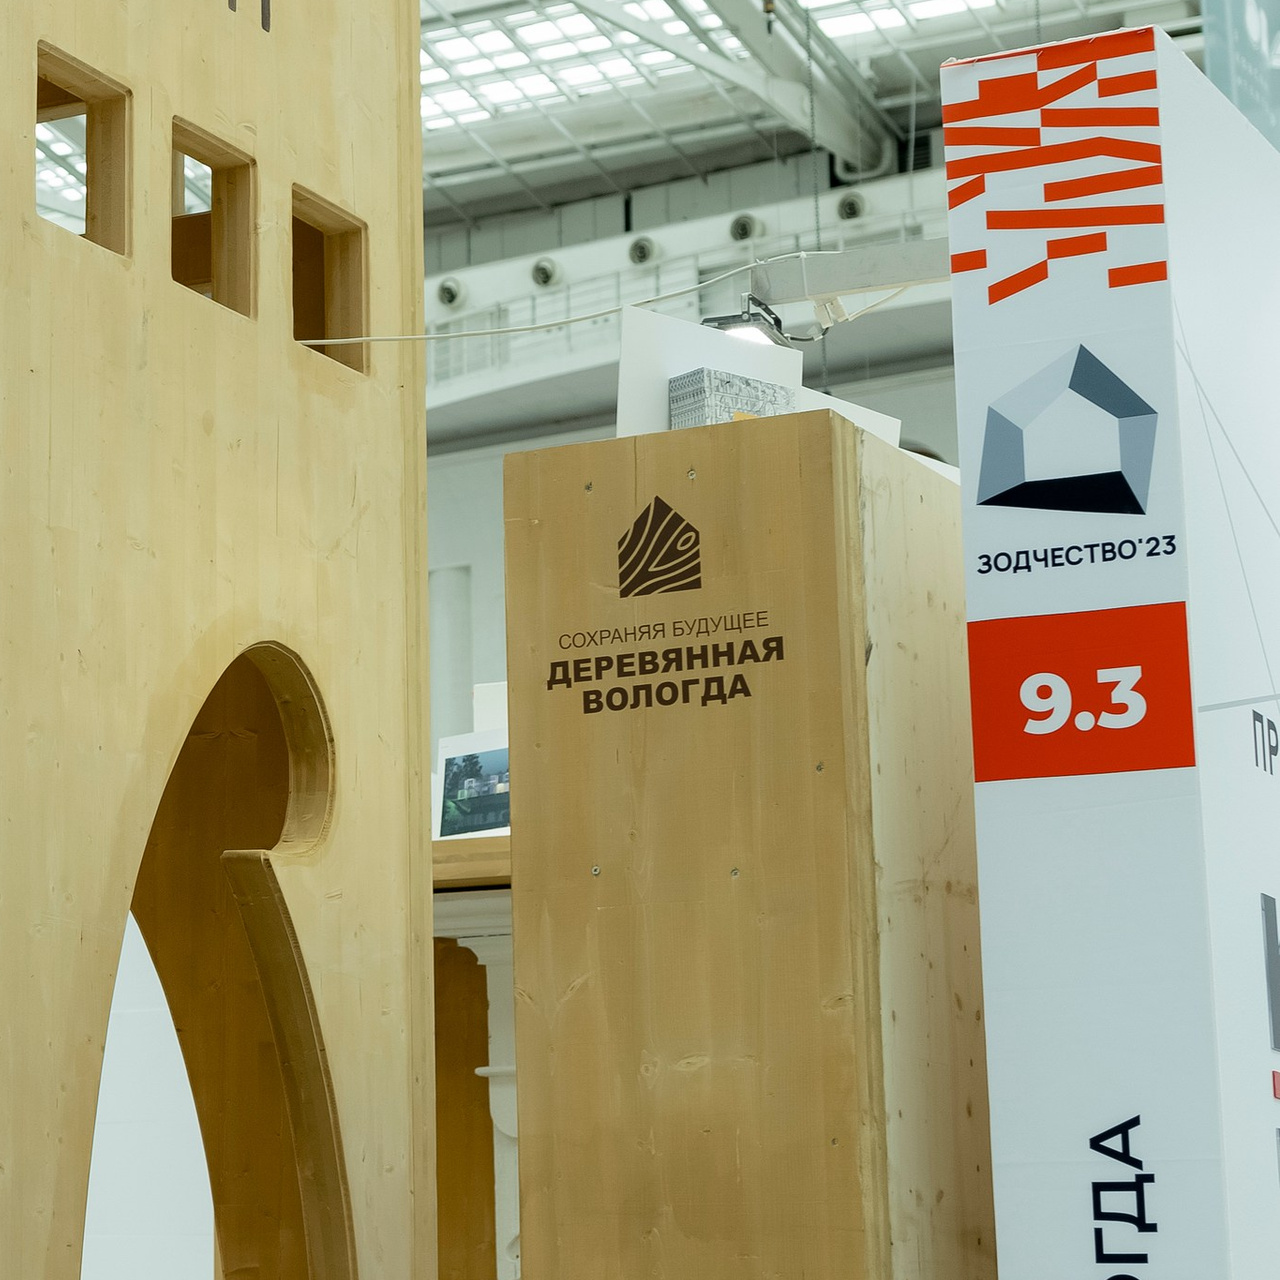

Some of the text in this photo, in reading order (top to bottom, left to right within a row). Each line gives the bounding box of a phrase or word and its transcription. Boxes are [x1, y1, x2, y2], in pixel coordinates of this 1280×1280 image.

[977, 534, 1177, 575] ЗОДЧЕСТВО'23
[558, 610, 769, 650] СОХРАНЯЯ БУДУЩЕЕ
[546, 636, 784, 690] ДЕРЕВЯННАЯ
[582, 674, 752, 714] ВОЛОГДА
[1019, 665, 1147, 735] 9.3
